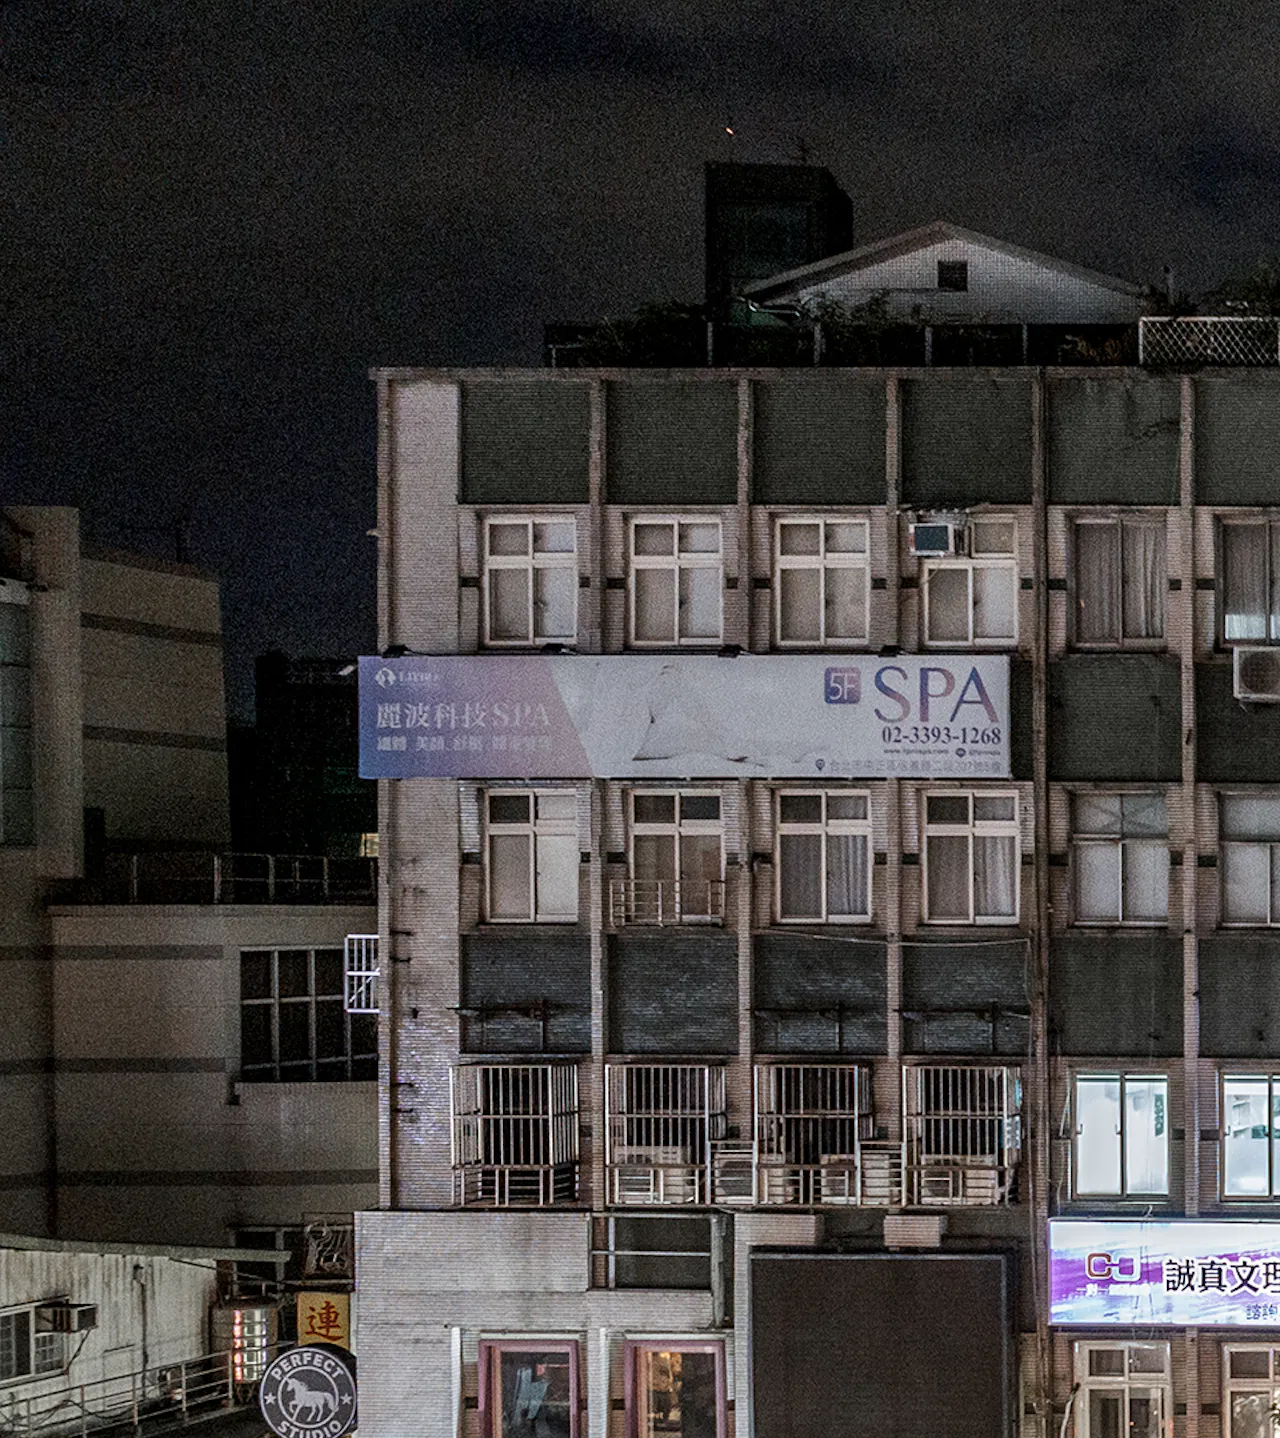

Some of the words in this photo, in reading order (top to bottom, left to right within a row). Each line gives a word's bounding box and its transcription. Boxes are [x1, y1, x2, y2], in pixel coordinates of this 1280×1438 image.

[829, 673, 857, 700] 5F
[874, 665, 1000, 723] SPA
[882, 726, 1001, 746] 02-3393-1268
[270, 1353, 345, 1382] PERFECT
